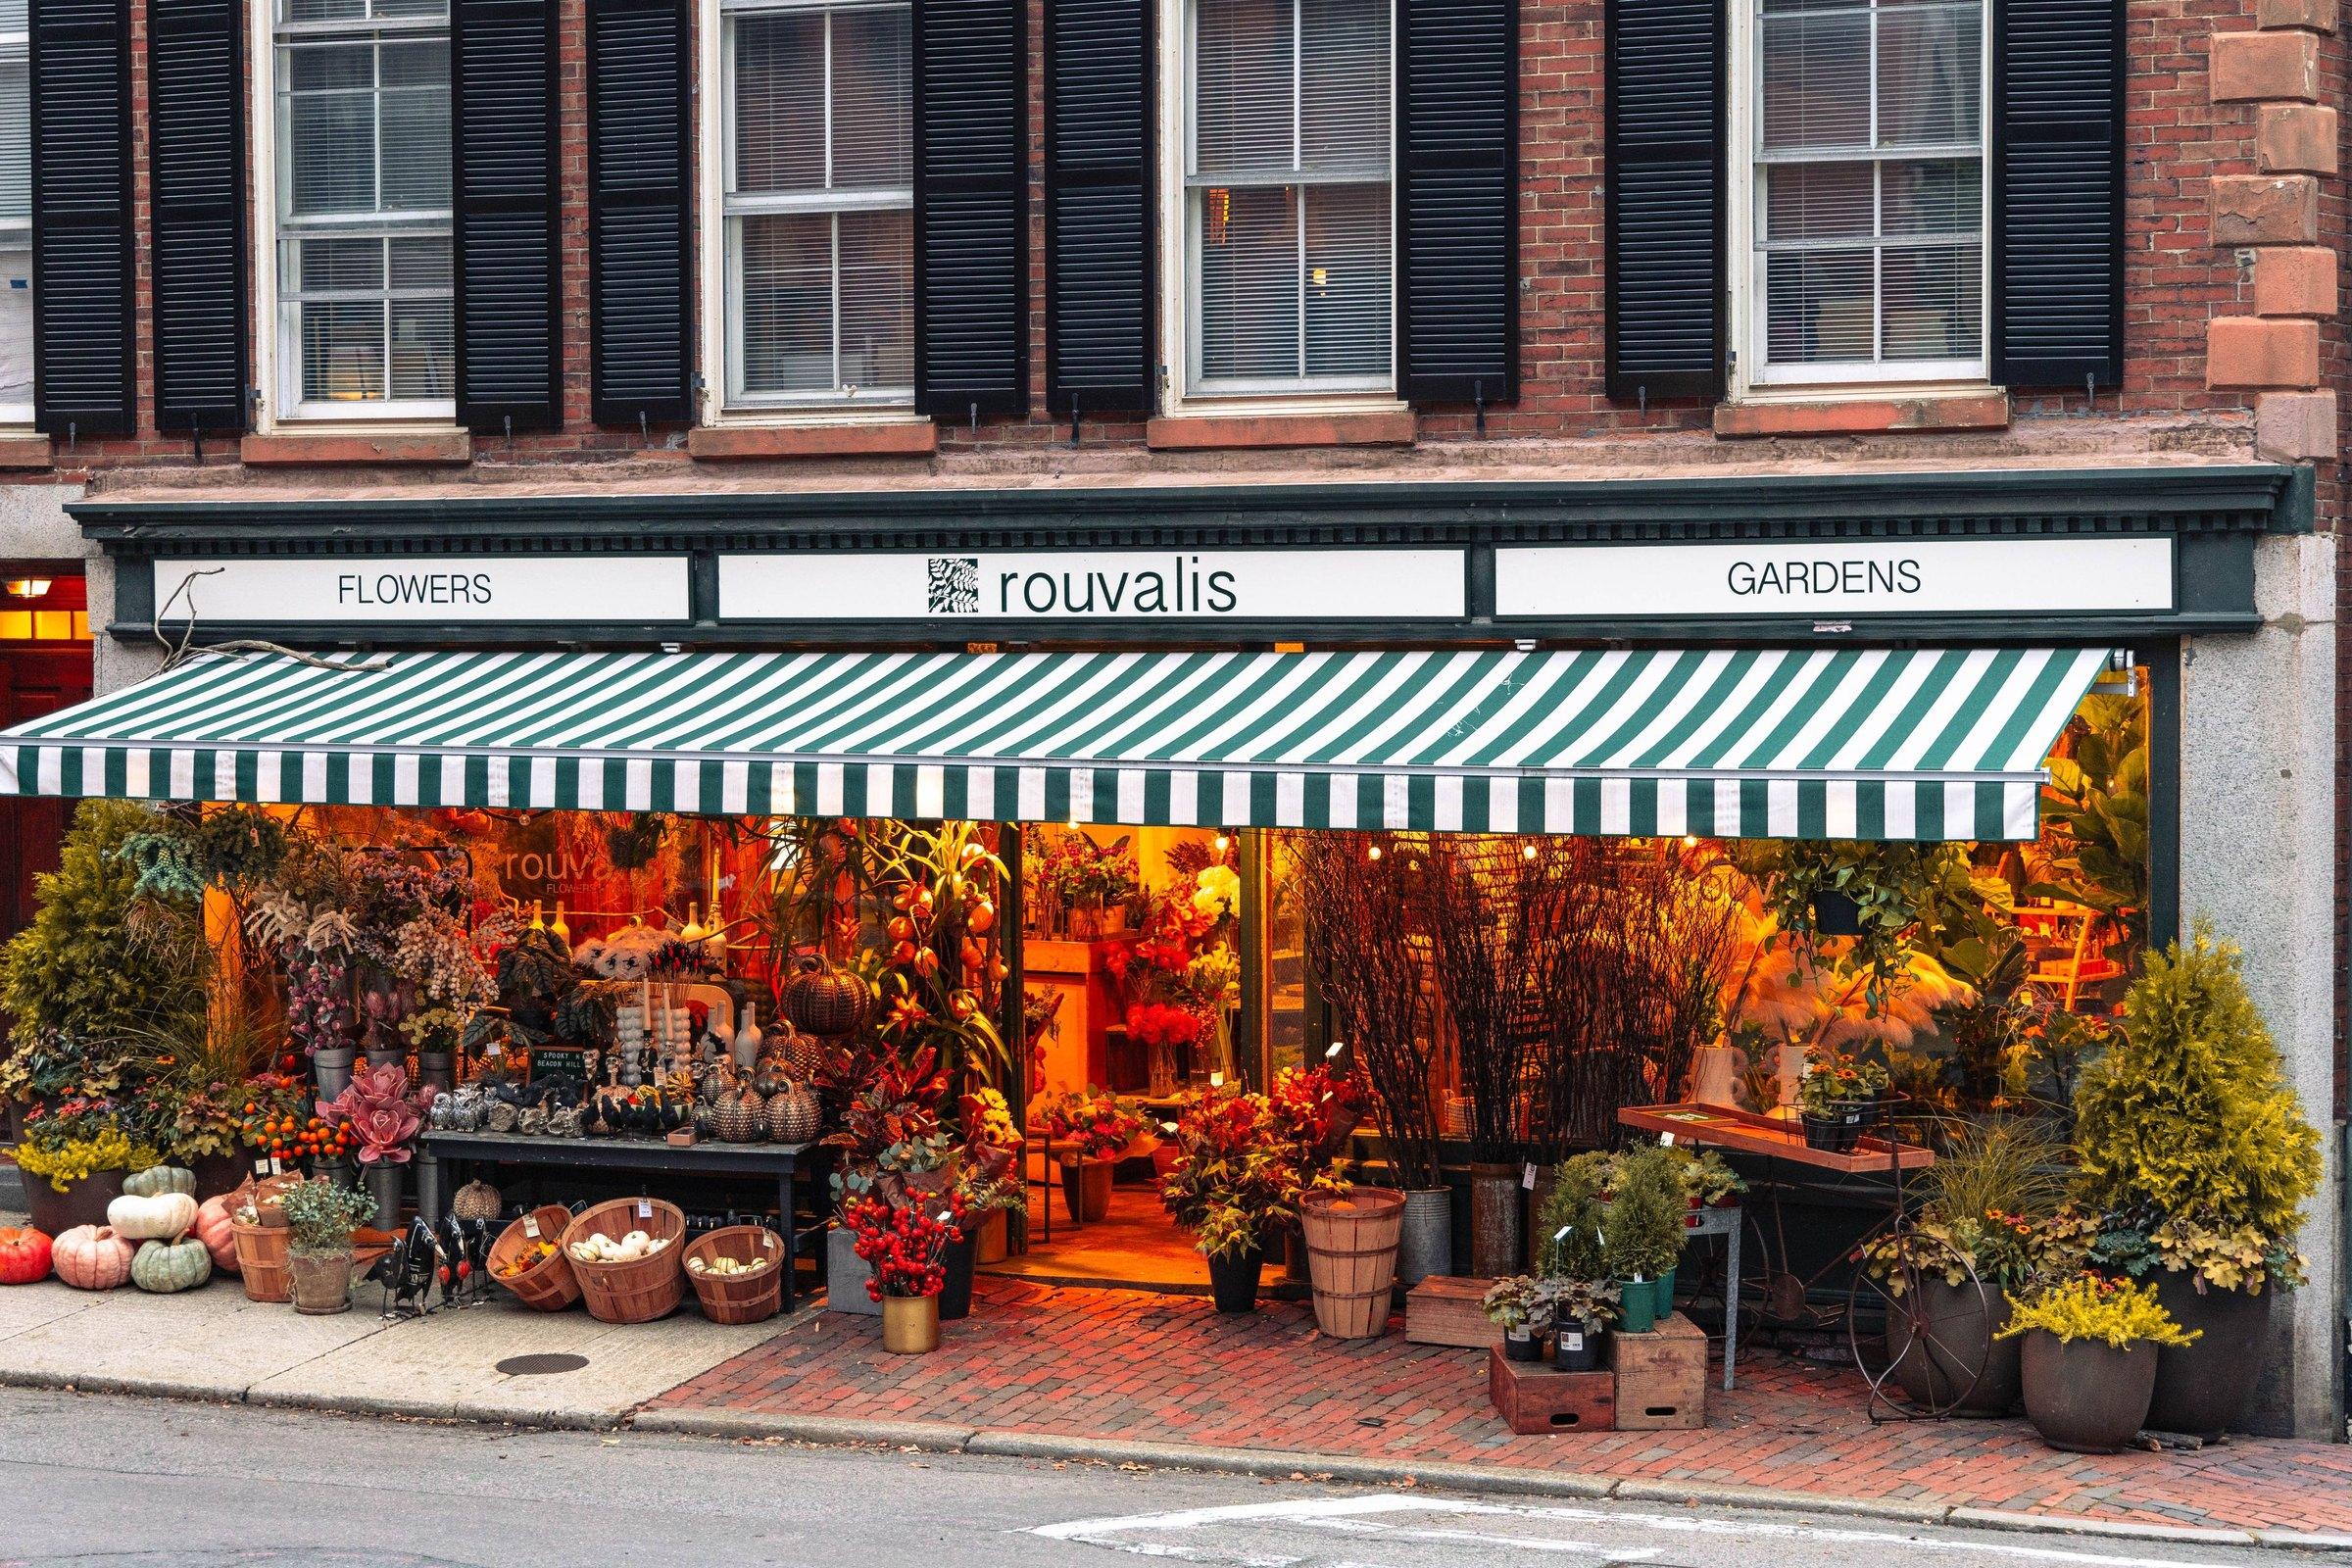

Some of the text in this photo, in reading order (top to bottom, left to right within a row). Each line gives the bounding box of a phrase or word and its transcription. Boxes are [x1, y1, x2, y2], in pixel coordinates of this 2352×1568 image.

[338, 573, 492, 605] FLOWERS
[1000, 556, 1238, 613] rouvalis
[1728, 559, 1921, 596] GARDENS
[505, 851, 617, 880] rouva
